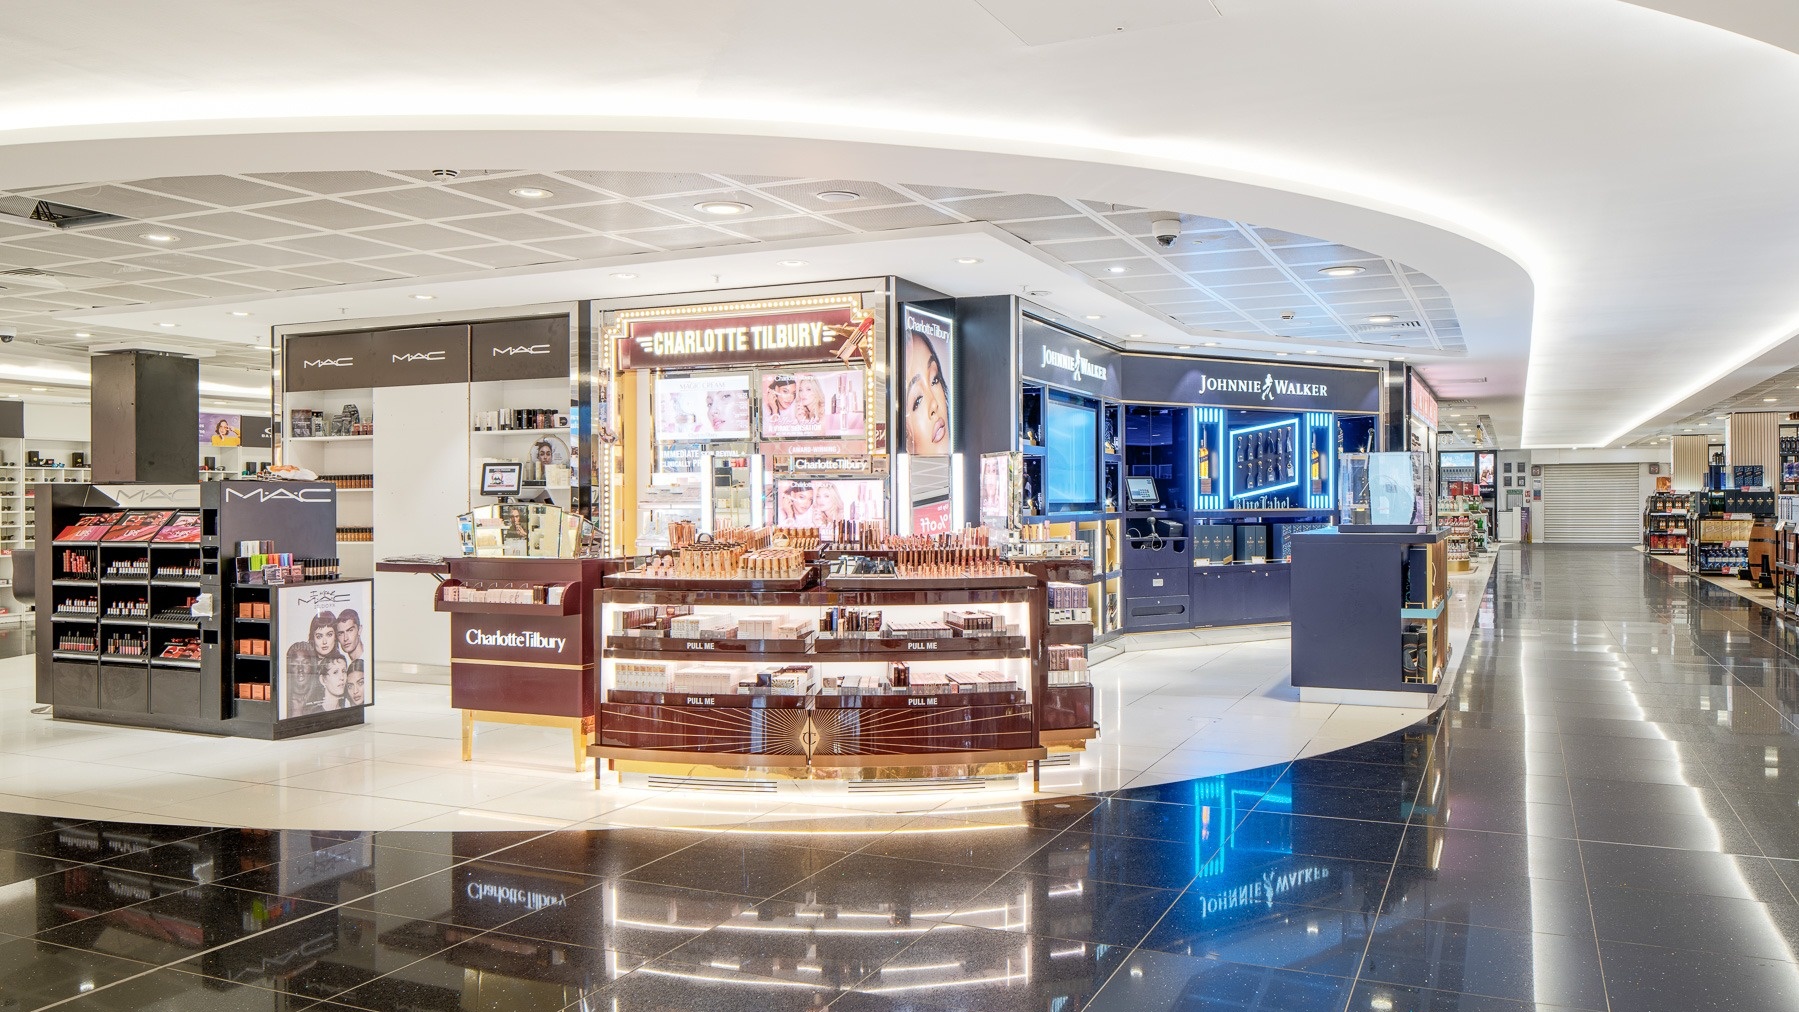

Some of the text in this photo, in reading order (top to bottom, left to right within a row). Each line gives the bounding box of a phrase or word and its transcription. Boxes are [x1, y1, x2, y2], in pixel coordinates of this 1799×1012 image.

[653, 322, 823, 355] CHARLOTTE TILBURY
[1041, 345, 1107, 381] JOHNNIE WALKER
[1199, 374, 1328, 396] JOHNNIE WALKER
[687, 642, 703, 650] PULL
[908, 642, 938, 650] PULL ME
[687, 697, 703, 705] PULL
[908, 698, 938, 706] PULL ME
